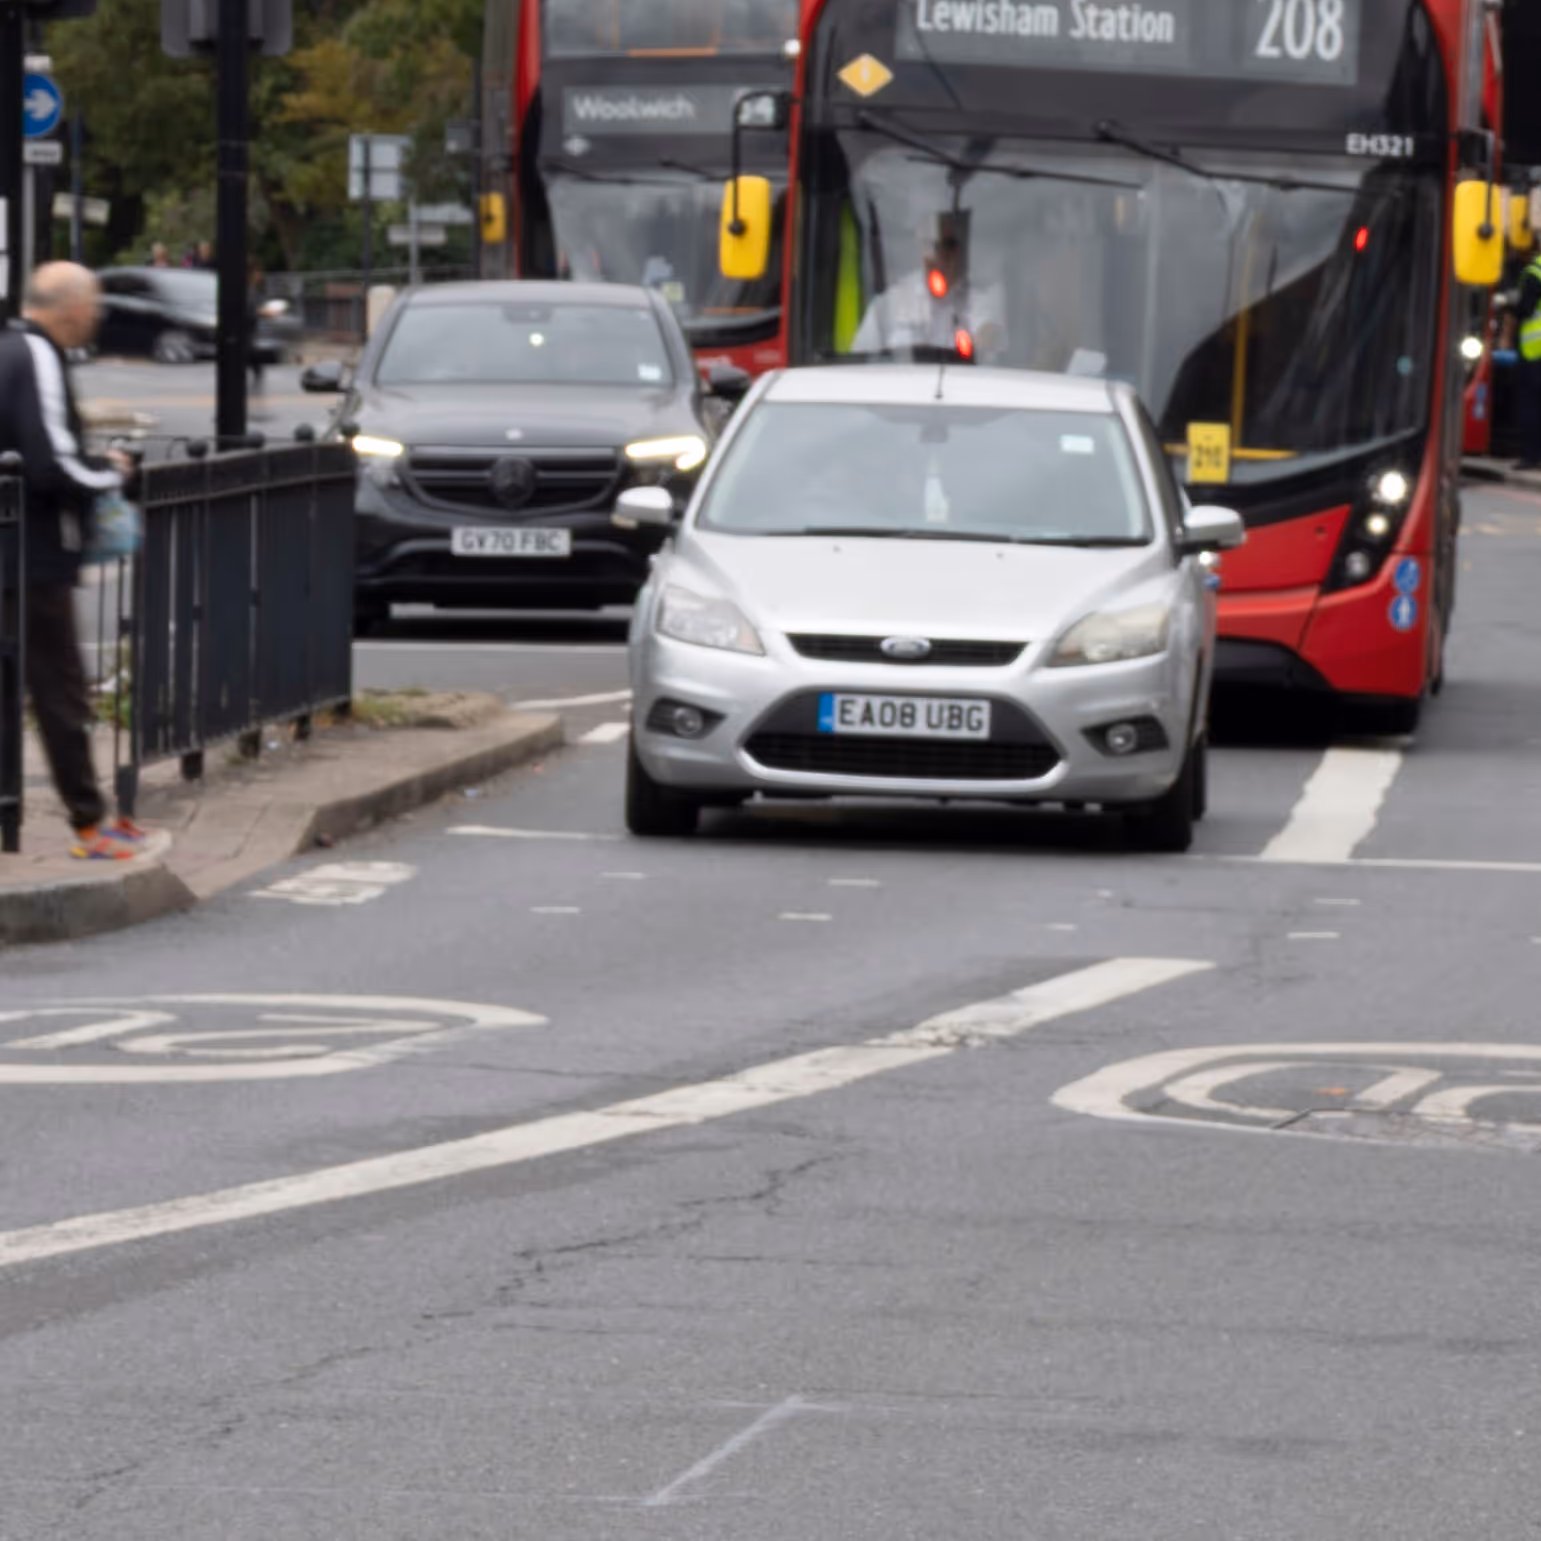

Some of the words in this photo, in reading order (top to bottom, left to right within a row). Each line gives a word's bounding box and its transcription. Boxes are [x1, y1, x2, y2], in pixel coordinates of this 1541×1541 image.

[573, 94, 696, 120] Woolwich
[1346, 133, 1414, 157] EH321
[838, 699, 917, 729] EA08
[926, 702, 984, 732] UBG
